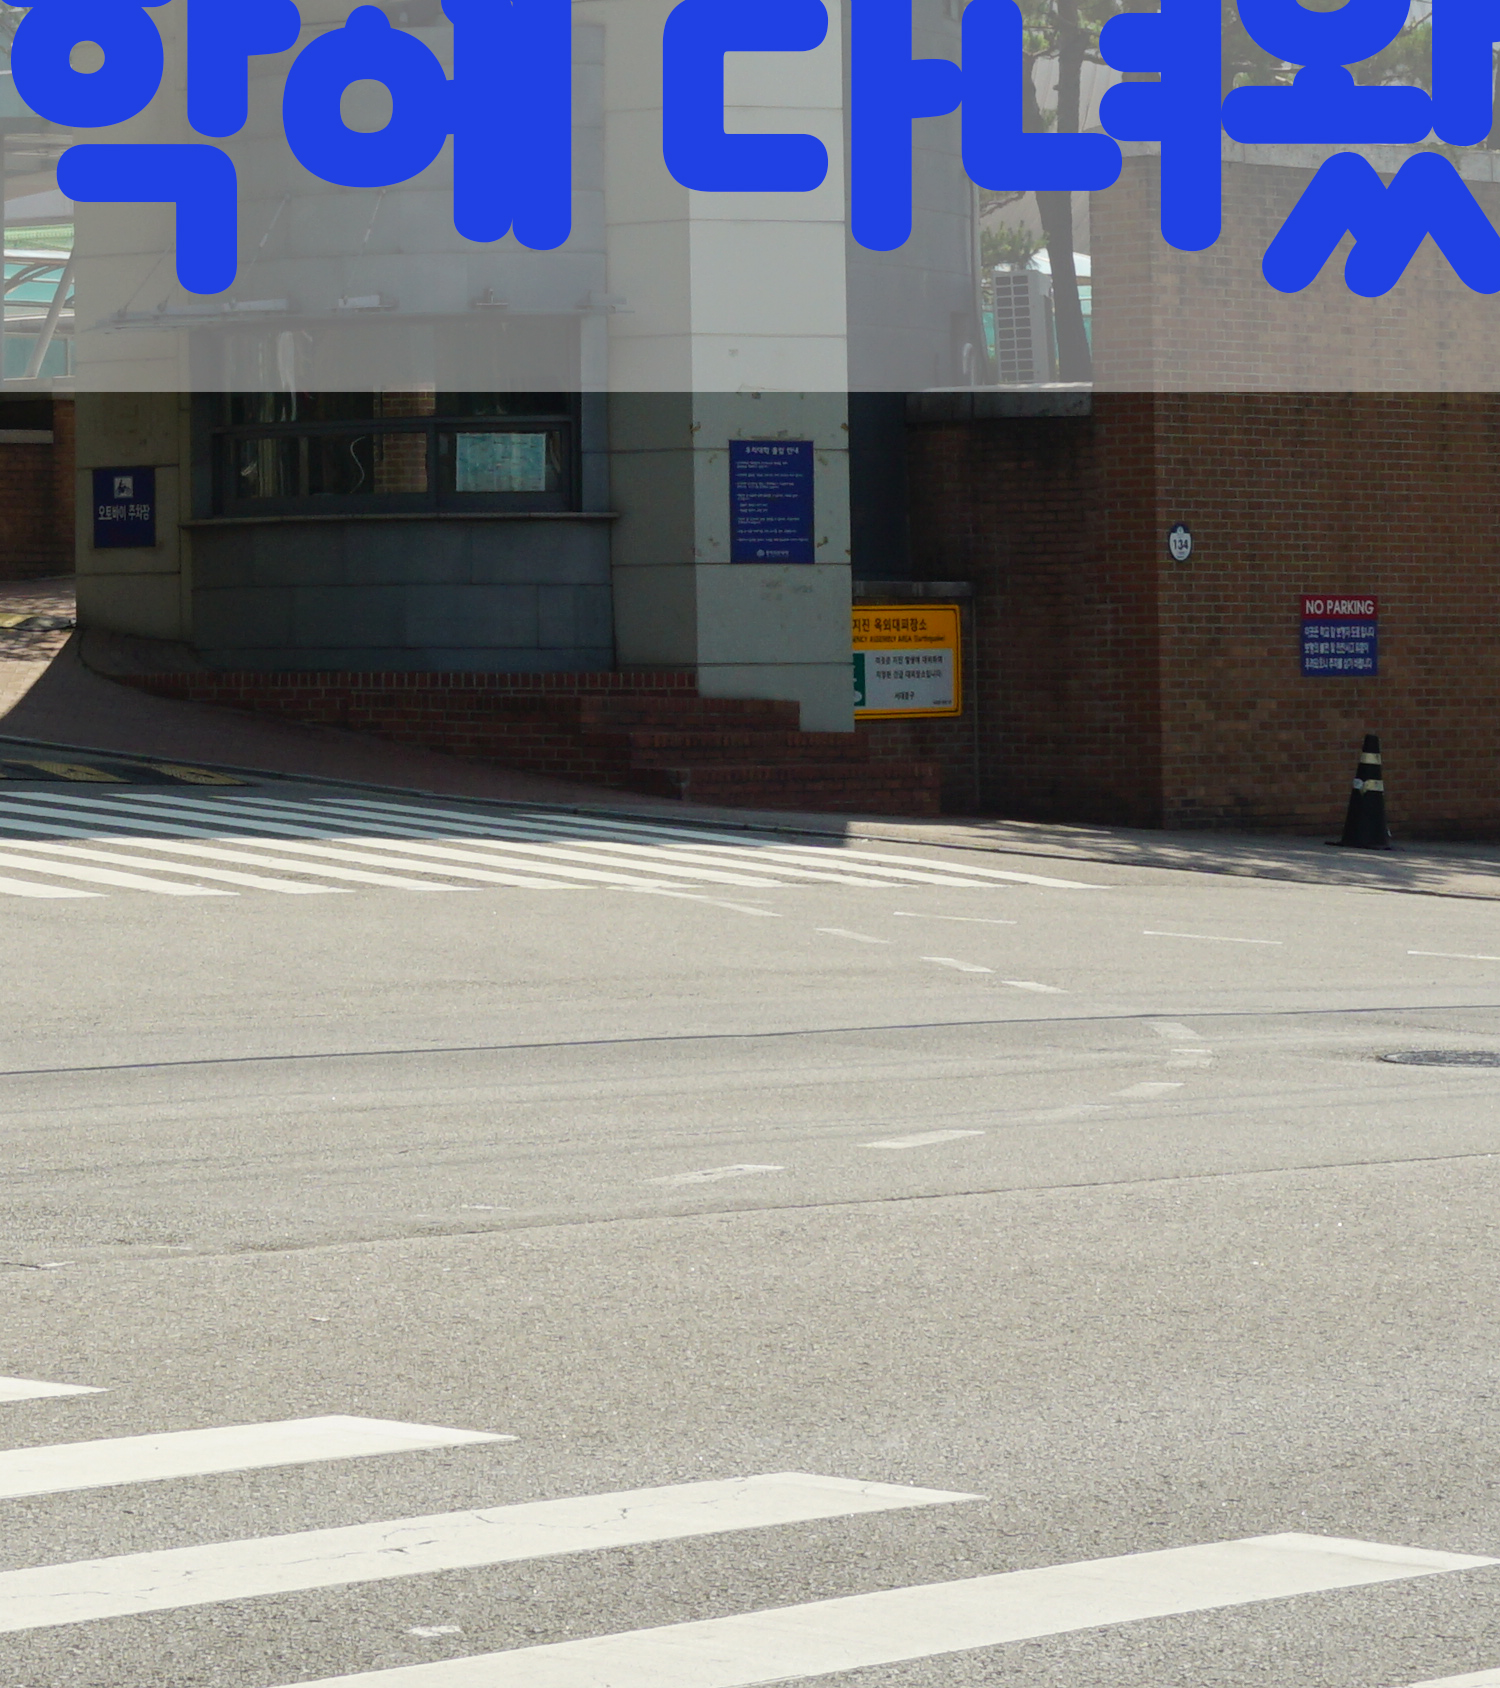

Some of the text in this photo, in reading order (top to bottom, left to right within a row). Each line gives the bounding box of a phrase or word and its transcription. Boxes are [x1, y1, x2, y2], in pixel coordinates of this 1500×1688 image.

[98, 504, 150, 521] 오토바이 주차장
[1173, 539, 1188, 550] 134
[1305, 599, 1375, 615] NO PARKING
[874, 617, 927, 632] 옥외대피장소
